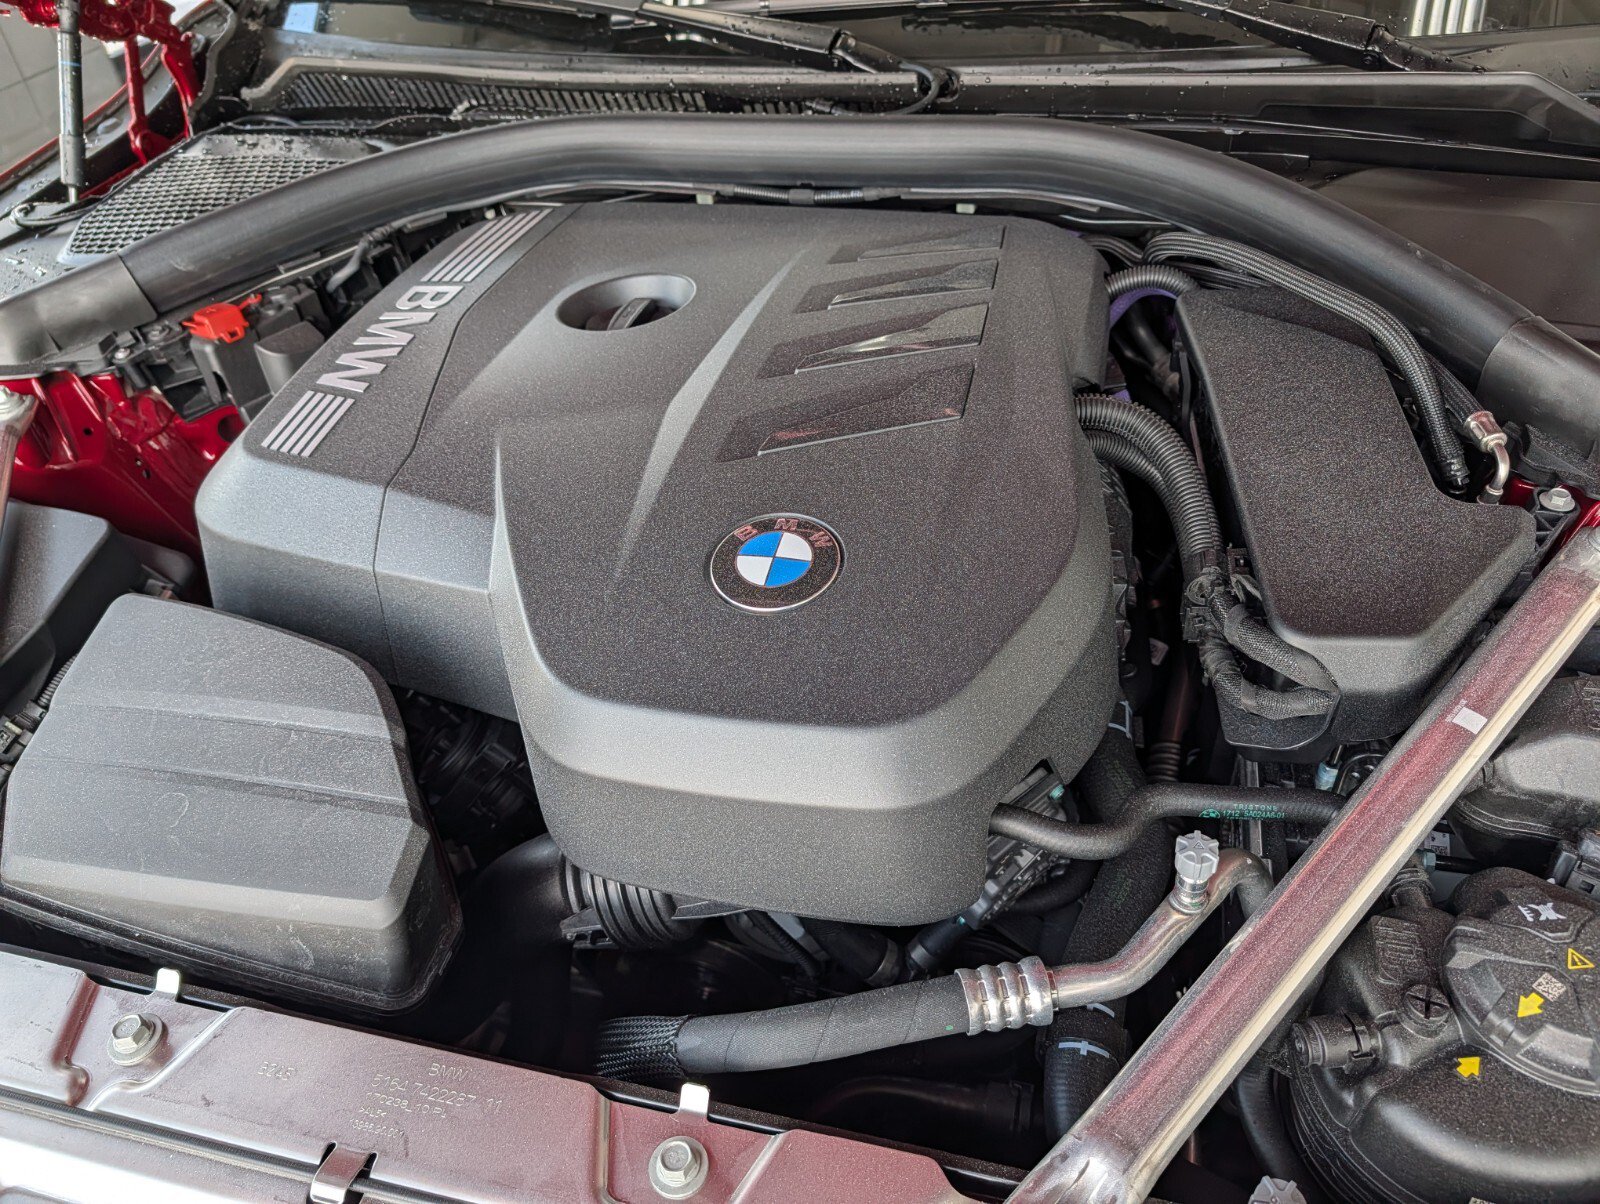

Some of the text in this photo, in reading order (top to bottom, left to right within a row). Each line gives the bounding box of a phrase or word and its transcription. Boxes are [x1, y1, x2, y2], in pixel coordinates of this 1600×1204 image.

[316, 285, 464, 393] BMW
[733, 518, 834, 548] BMW
[1222, 810, 1240, 818] 1712
[1232, 803, 1279, 812] TRISTONE
[428, 1062, 469, 1082] BMW
